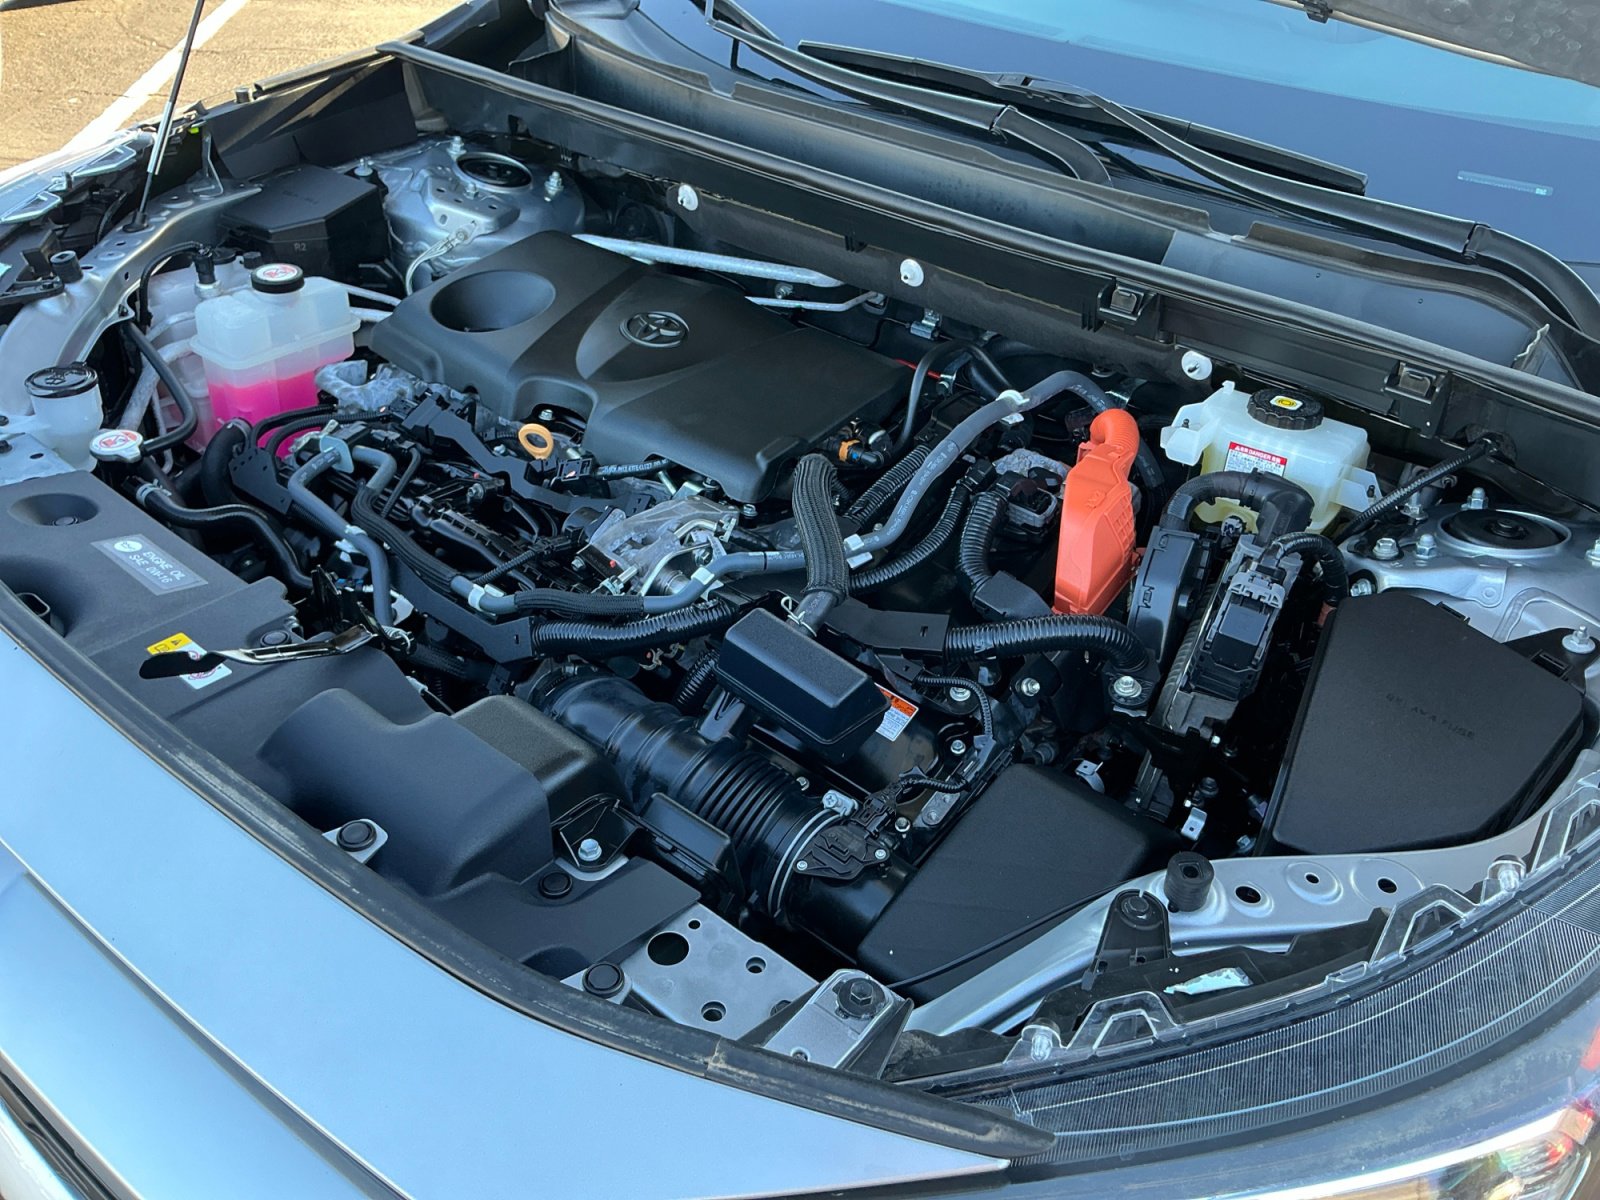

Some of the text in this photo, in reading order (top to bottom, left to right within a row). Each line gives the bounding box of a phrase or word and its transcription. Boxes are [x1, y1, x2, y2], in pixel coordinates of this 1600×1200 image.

[1249, 448, 1272, 462] DANGER
[128, 554, 150, 566] SAE
[142, 551, 186, 581] ENGINE OIL
